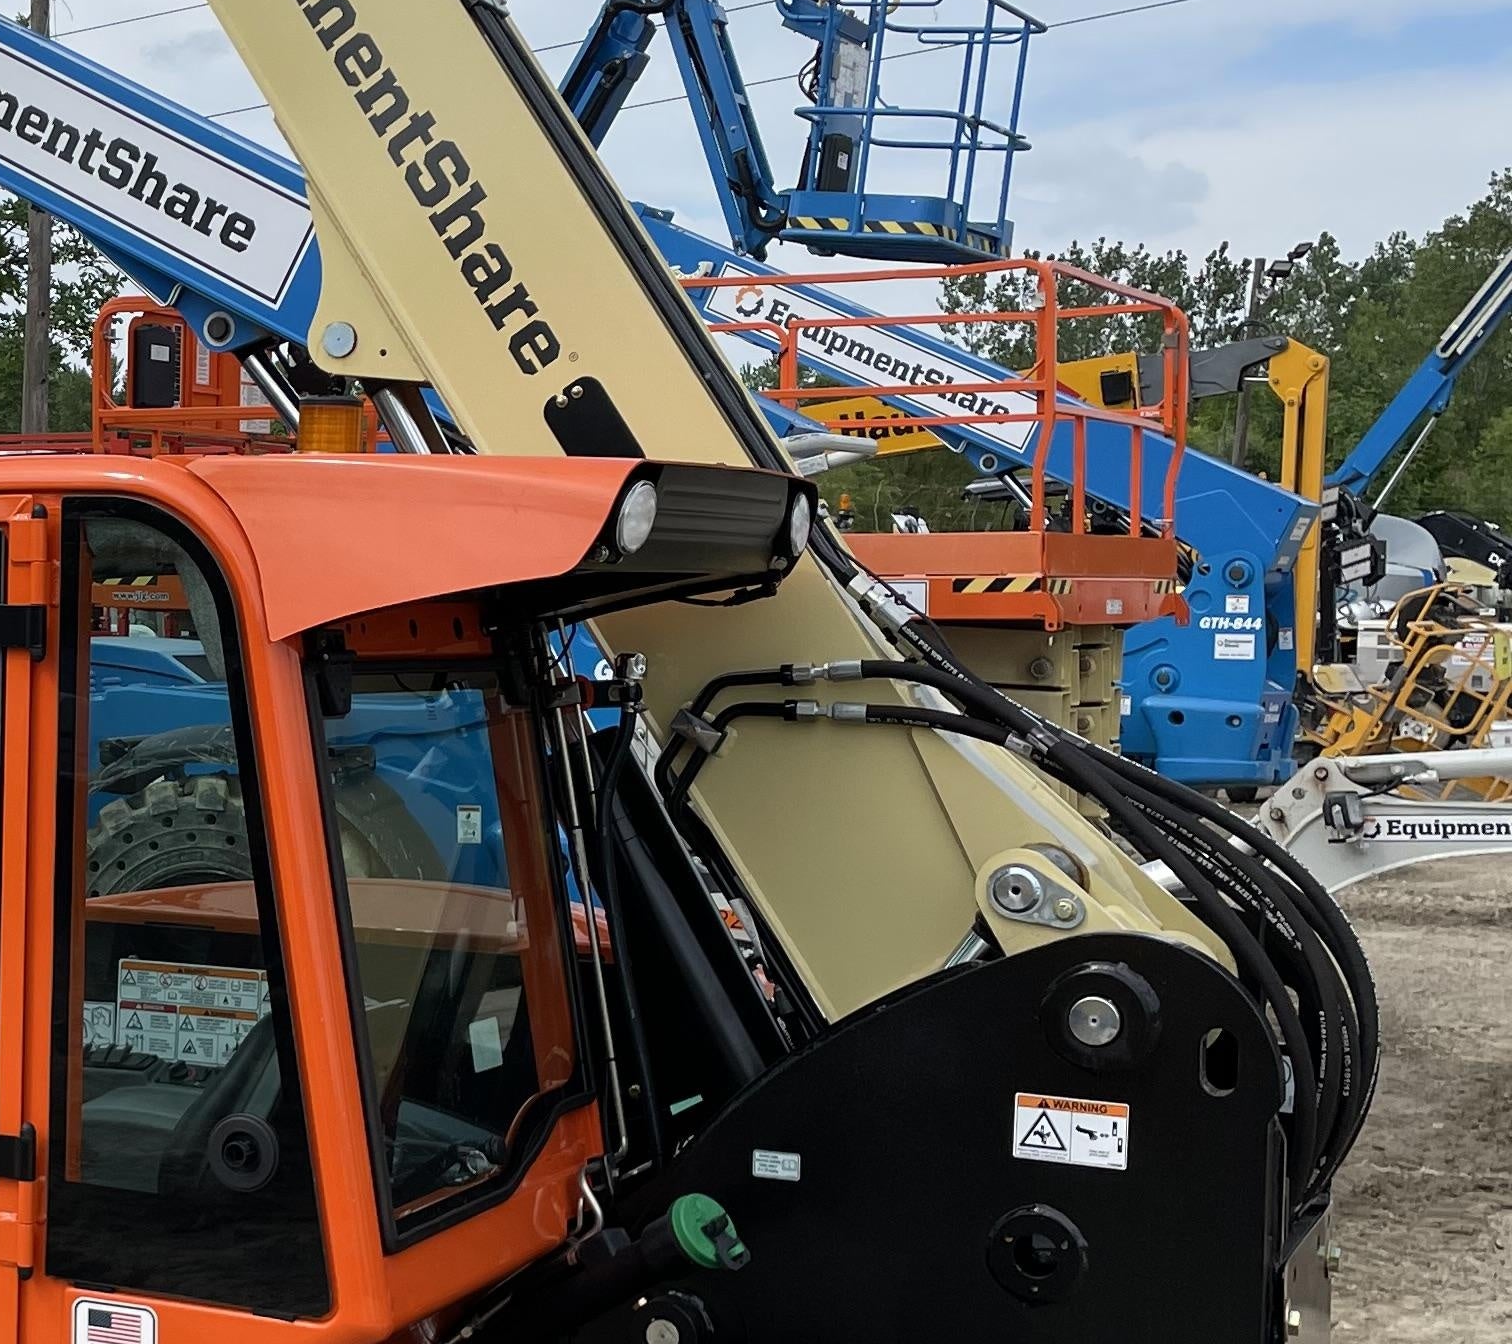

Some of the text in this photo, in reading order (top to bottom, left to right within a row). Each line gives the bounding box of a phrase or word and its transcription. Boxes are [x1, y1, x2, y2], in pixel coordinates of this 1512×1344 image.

[838, 410, 926, 440] Hau
[112, 590, 169, 603] www.jlg.com
[1199, 616, 1262, 631] GTH-844
[1386, 819, 1512, 839] Equipmen
[1053, 1100, 1108, 1114] WARNING
